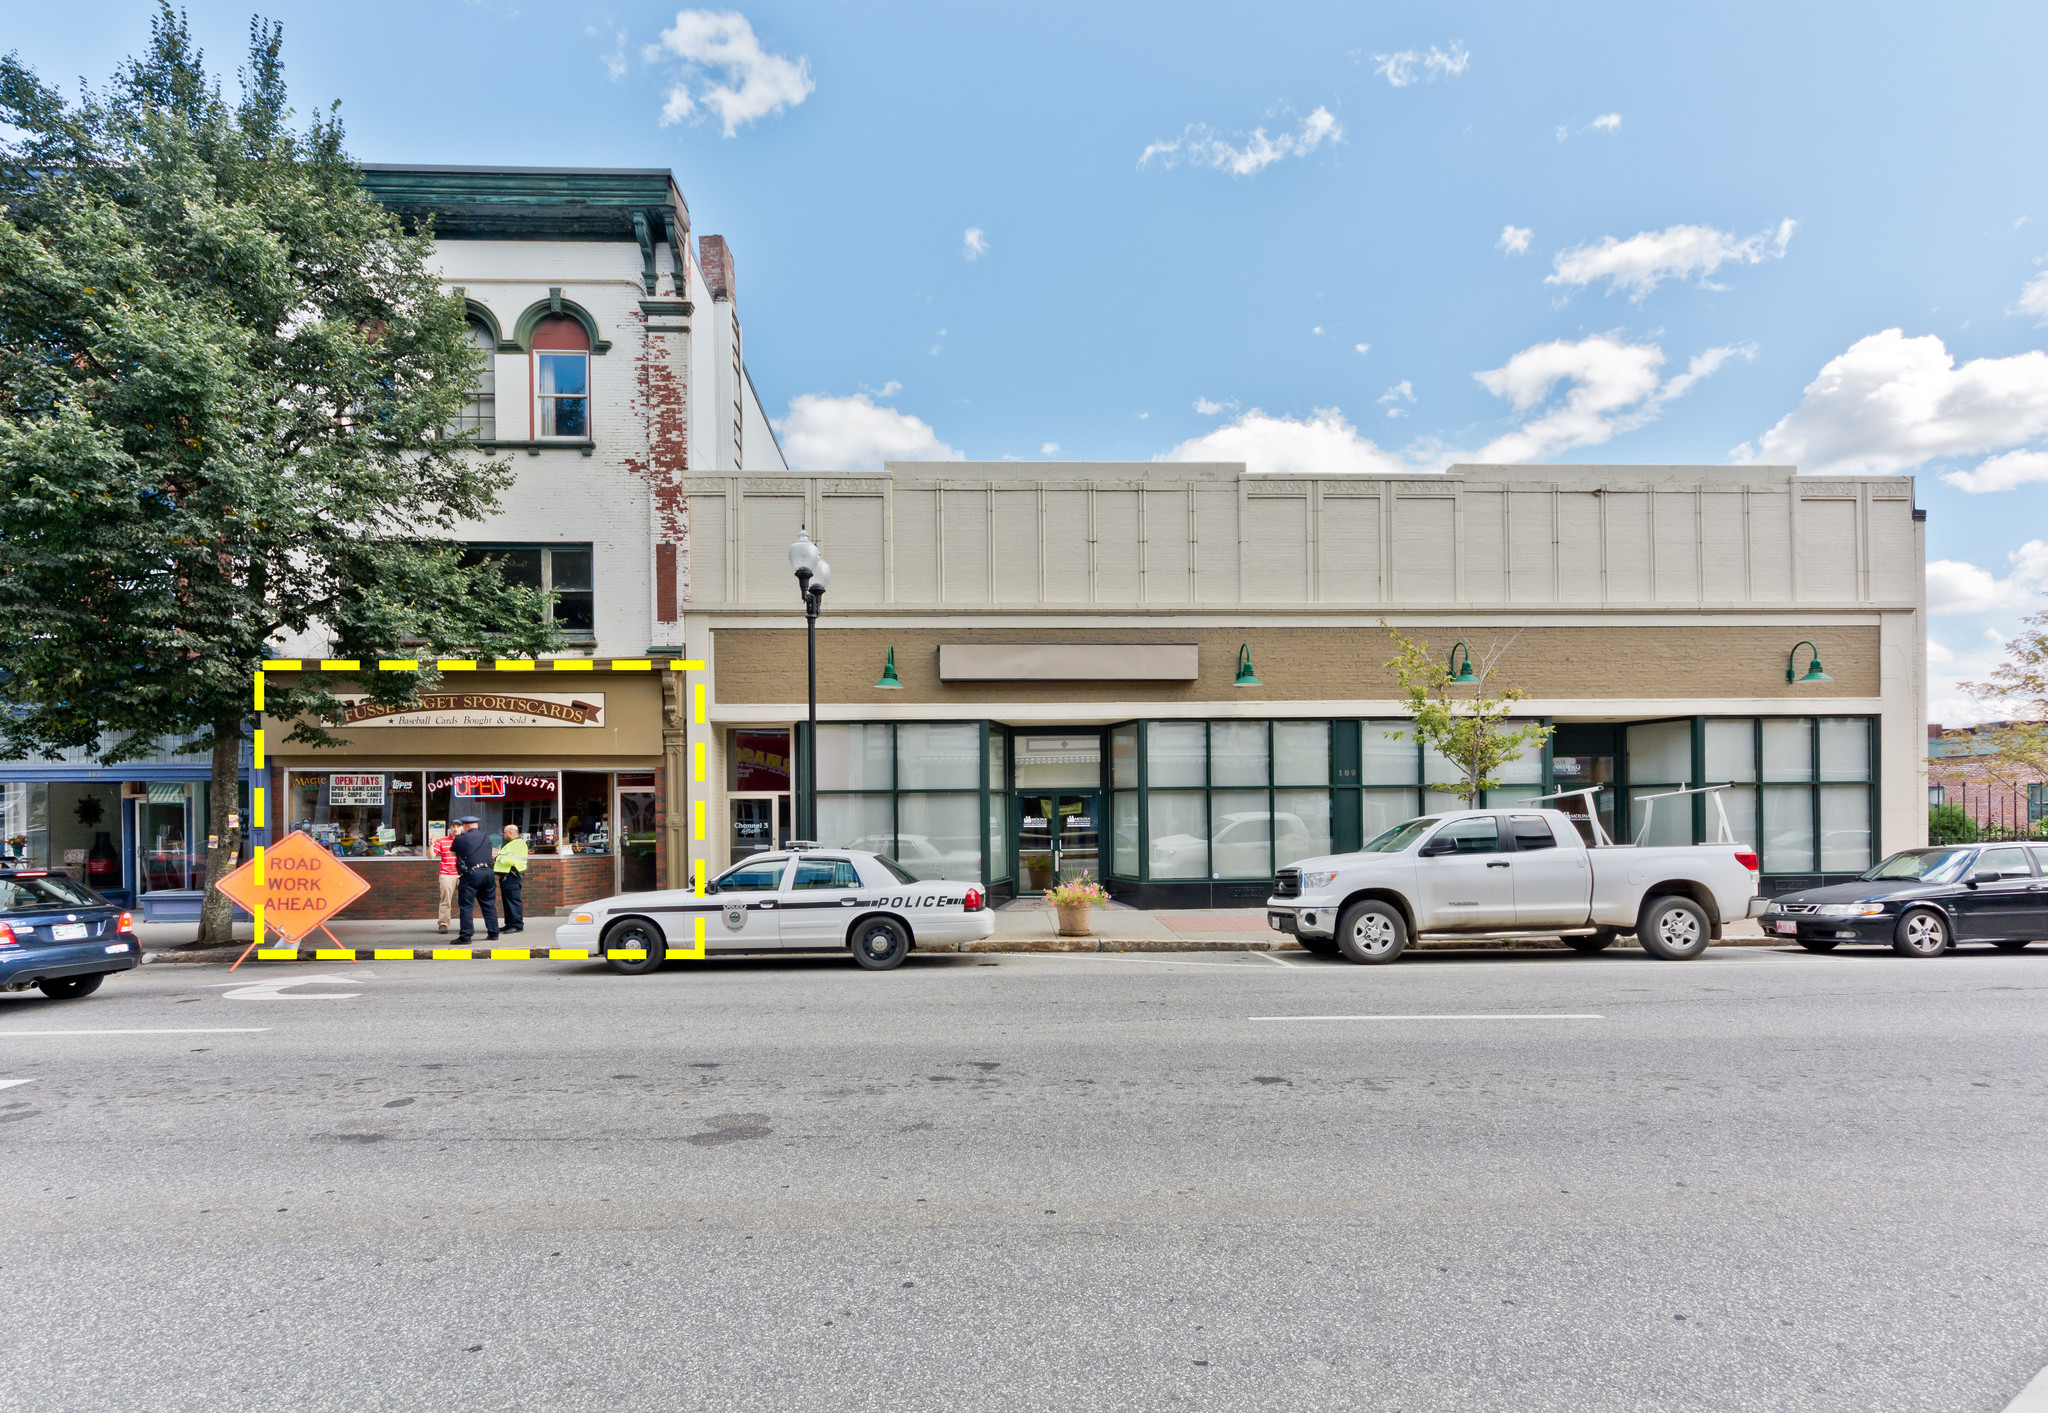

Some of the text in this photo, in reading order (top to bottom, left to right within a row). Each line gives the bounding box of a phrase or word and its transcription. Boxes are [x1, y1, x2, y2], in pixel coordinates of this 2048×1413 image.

[344, 696, 584, 722] FUSSDGET SPORTSCARDS
[398, 716, 527, 725] Baseball Cards Bought & Sold
[293, 777, 327, 786] MAGIC
[335, 777, 379, 785] OPEN 7 DAYS
[428, 775, 555, 792] DOWNTOWN AUGUSTA
[456, 777, 504, 795] OPEN
[270, 858, 321, 870] ROAD
[268, 878, 321, 891] WORK
[264, 898, 327, 910] AHEAD
[877, 896, 947, 908] POLICE
